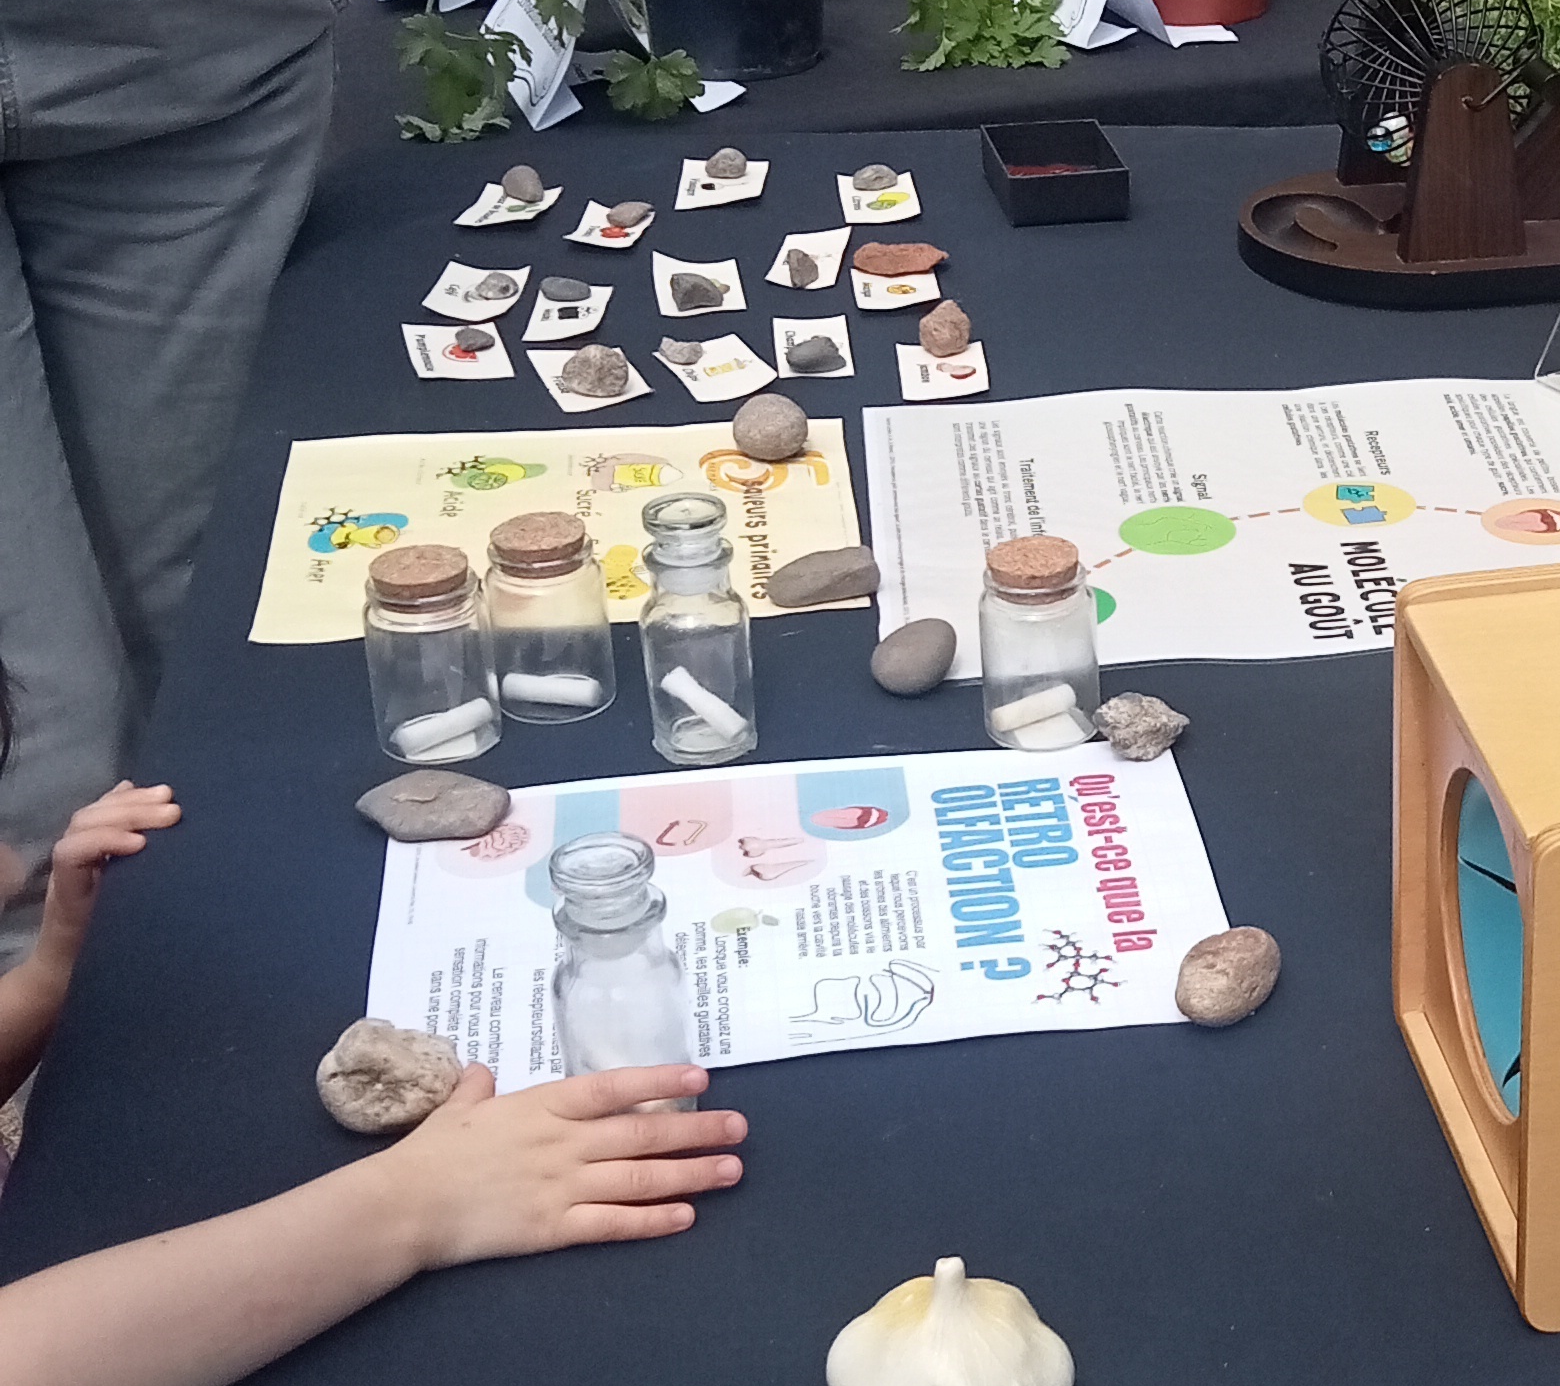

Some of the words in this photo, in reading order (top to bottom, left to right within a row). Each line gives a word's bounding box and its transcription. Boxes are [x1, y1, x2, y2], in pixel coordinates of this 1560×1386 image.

[1018, 457, 1040, 503] Traitement
[1190, 472, 1213, 501] Signal
[438, 489, 465, 519] Acide
[575, 488, 603, 518] Sucré
[741, 480, 769, 530] saveurs
[1288, 562, 1334, 588] AU
[1298, 591, 1364, 641] GOÛT
[1069, 772, 1132, 872] Qu'est-ce
[930, 783, 1026, 950] OLFACTION
[1095, 875, 1146, 924] que
[712, 934, 728, 970] Lorsque
[734, 925, 751, 968] Exemple:
[1113, 928, 1158, 954] la
[716, 971, 728, 994] vous
[960, 955, 1033, 982] ?
[714, 995, 731, 1037] croquez
[718, 1037, 731, 1055] une
